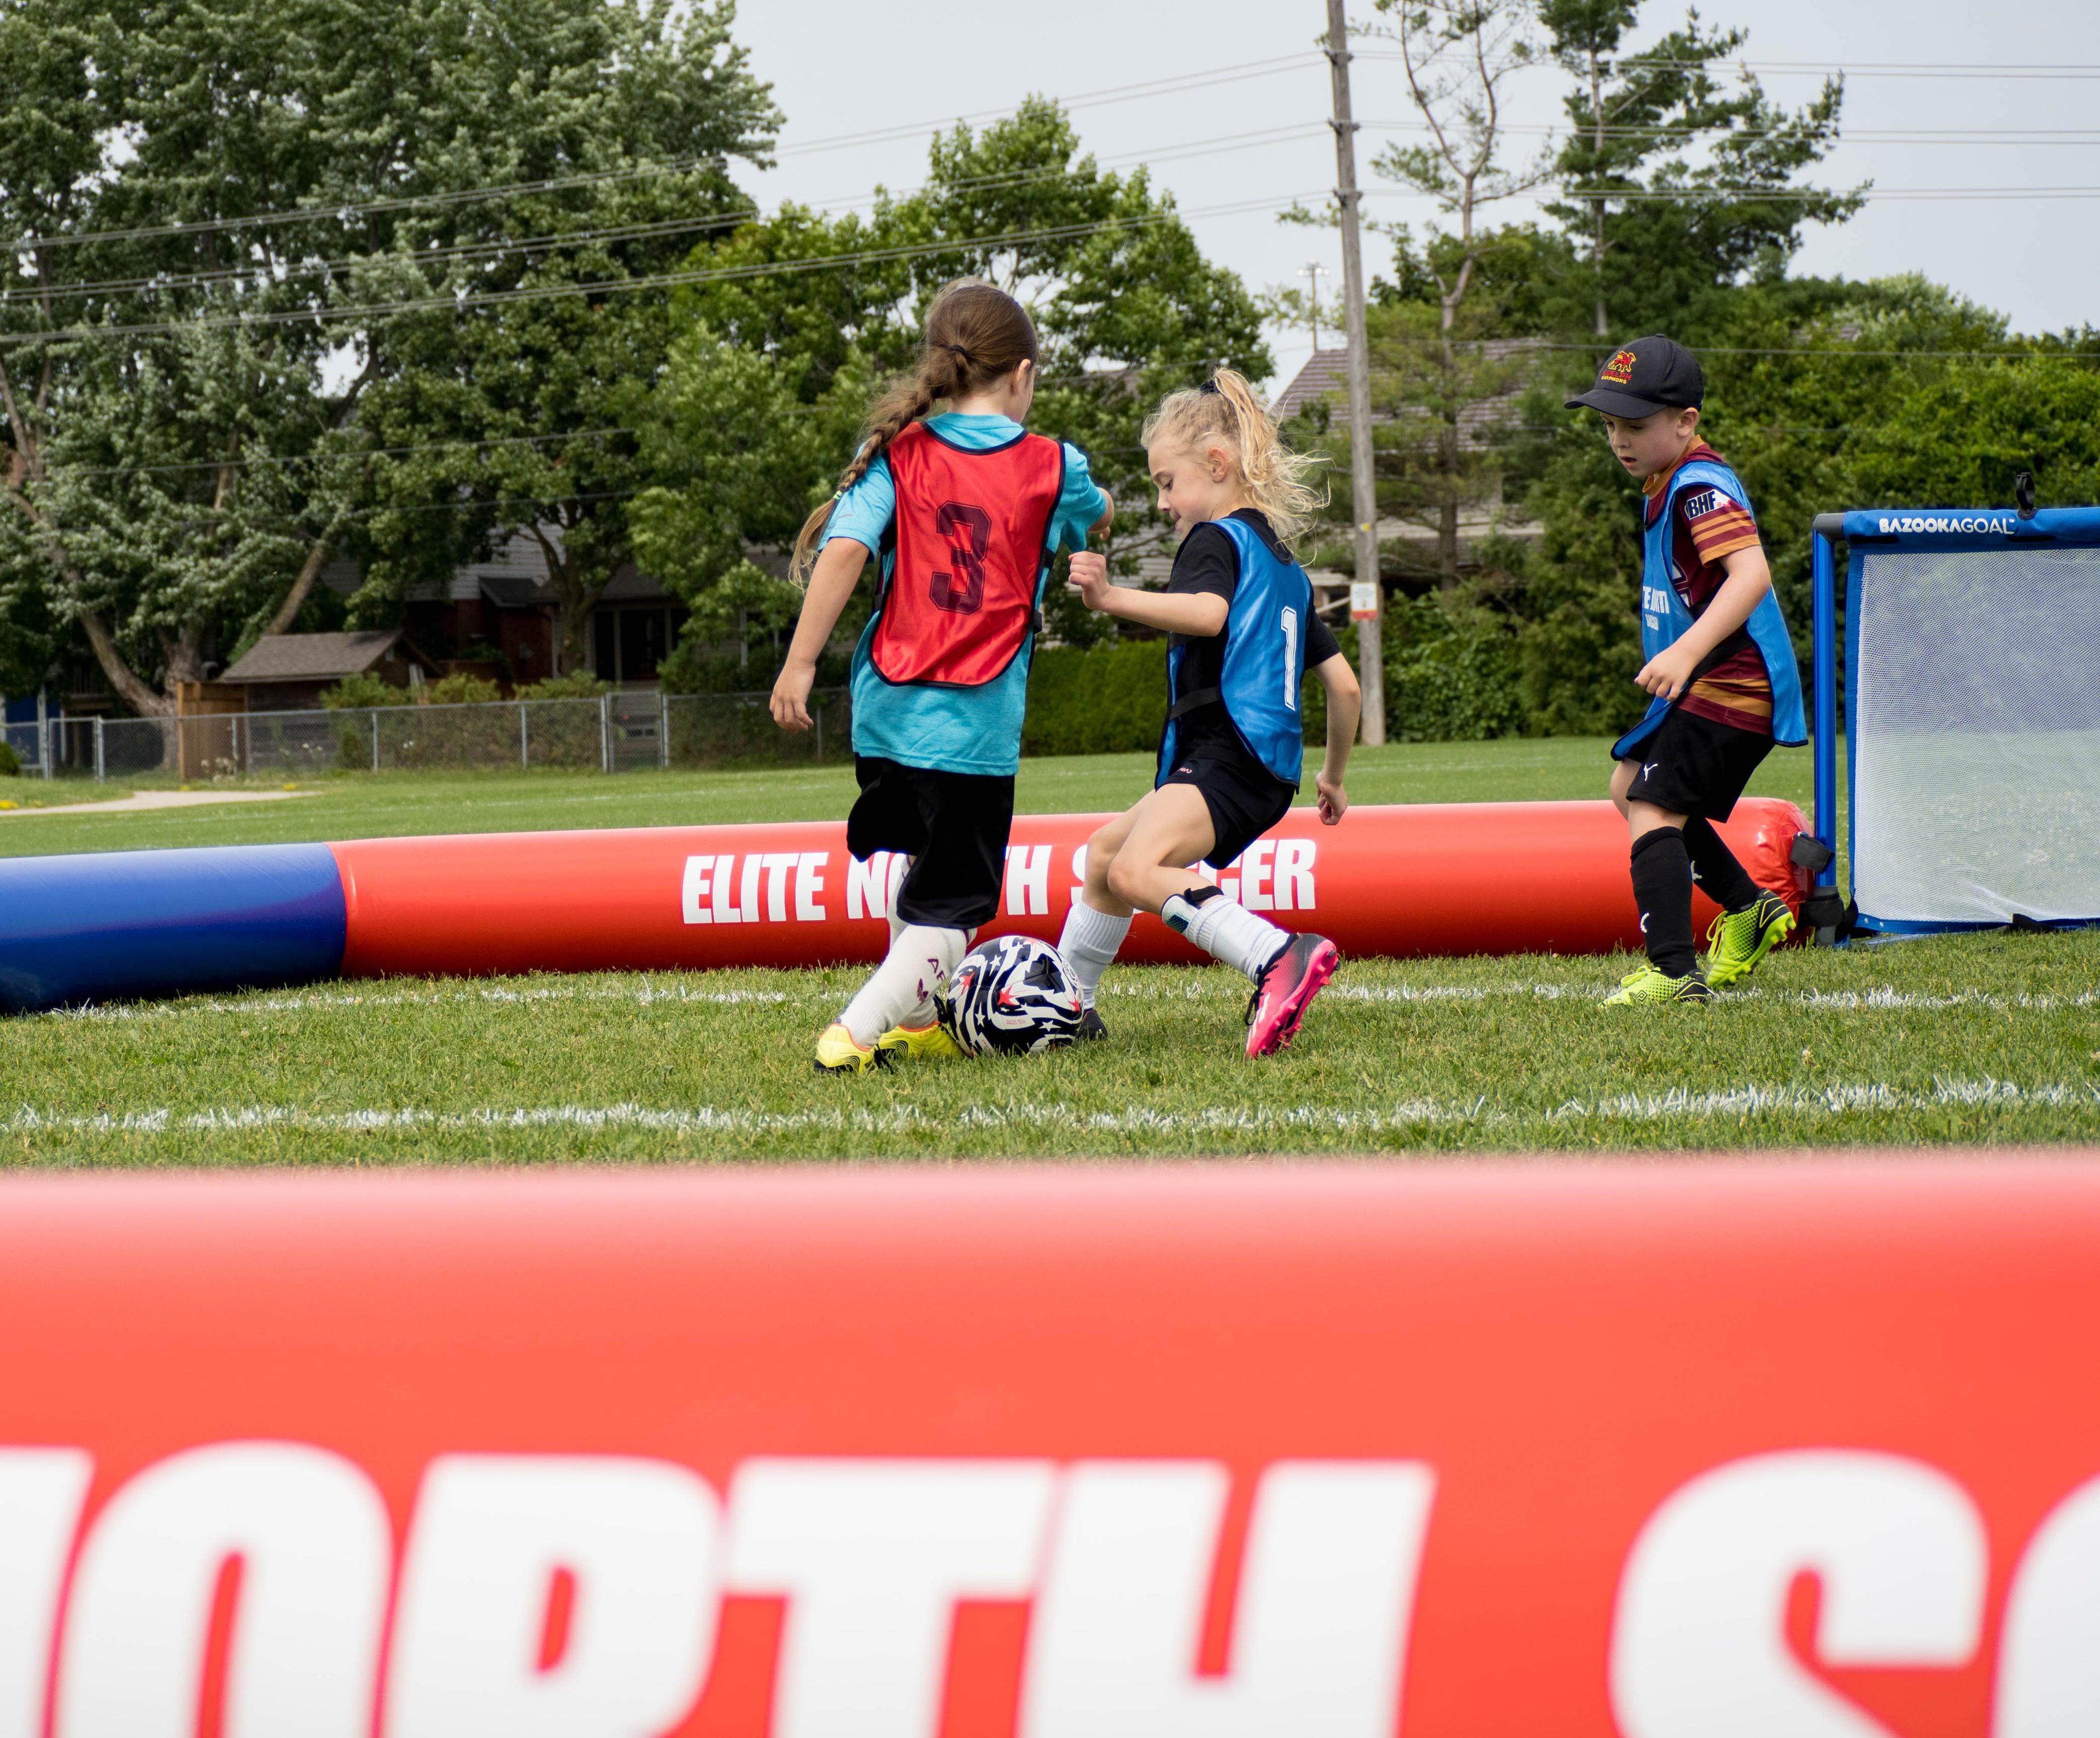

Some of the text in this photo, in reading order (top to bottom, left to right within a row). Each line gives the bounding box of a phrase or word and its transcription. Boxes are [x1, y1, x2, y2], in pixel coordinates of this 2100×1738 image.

[930, 500, 992, 615] 3
[1281, 605, 1297, 711] 1
[682, 852, 829, 924] ELITE
